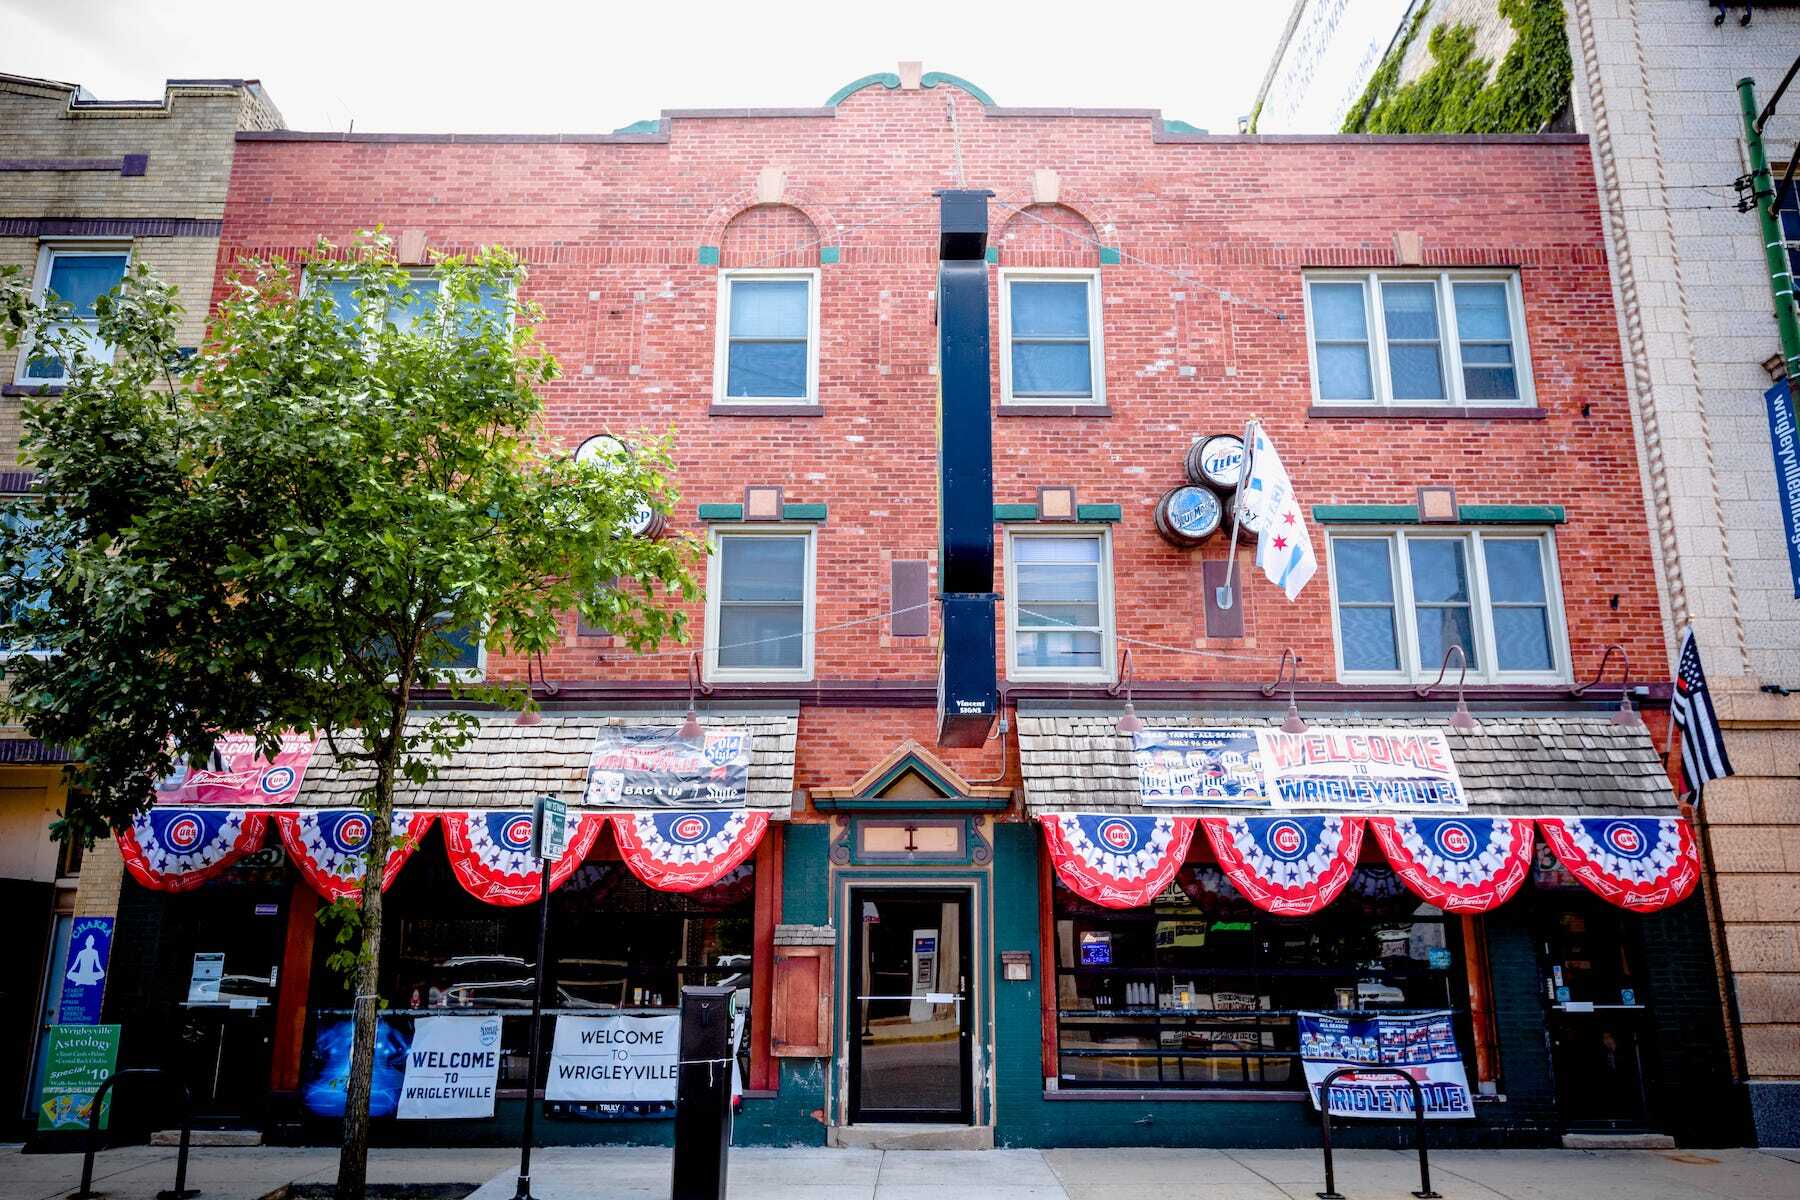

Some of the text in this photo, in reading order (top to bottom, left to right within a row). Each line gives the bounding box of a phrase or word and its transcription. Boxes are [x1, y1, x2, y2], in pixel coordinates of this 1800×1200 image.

[718, 737, 737, 749] Old
[708, 747, 737, 763] Style
[1266, 734, 1450, 773] WELCOME
[1355, 765, 1368, 775] TO
[624, 786, 683, 796] BACK IN
[707, 784, 737, 802] Style
[1276, 777, 1461, 805] WRIGLEYVILLE!
[172, 820, 198, 846] CUBS
[676, 819, 704, 839] CUBS
[1104, 823, 1132, 848] CUBS
[1273, 826, 1300, 853] CUBS
[1442, 828, 1469, 854] CUBS
[1611, 828, 1639, 851] CUBS
[73, 920, 112, 939] CHAKRA
[55, 1036, 112, 1051] Astrology
[581, 1031, 664, 1044] WELCOME
[413, 1052, 495, 1068] WELCOME
[611, 1050, 628, 1061] TO
[50, 1065, 86, 1079] Special
[444, 1072, 459, 1083] TO
[559, 1065, 678, 1080] WRIGLEYVILLE
[406, 1087, 491, 1099] WRIGLEYVILLE
